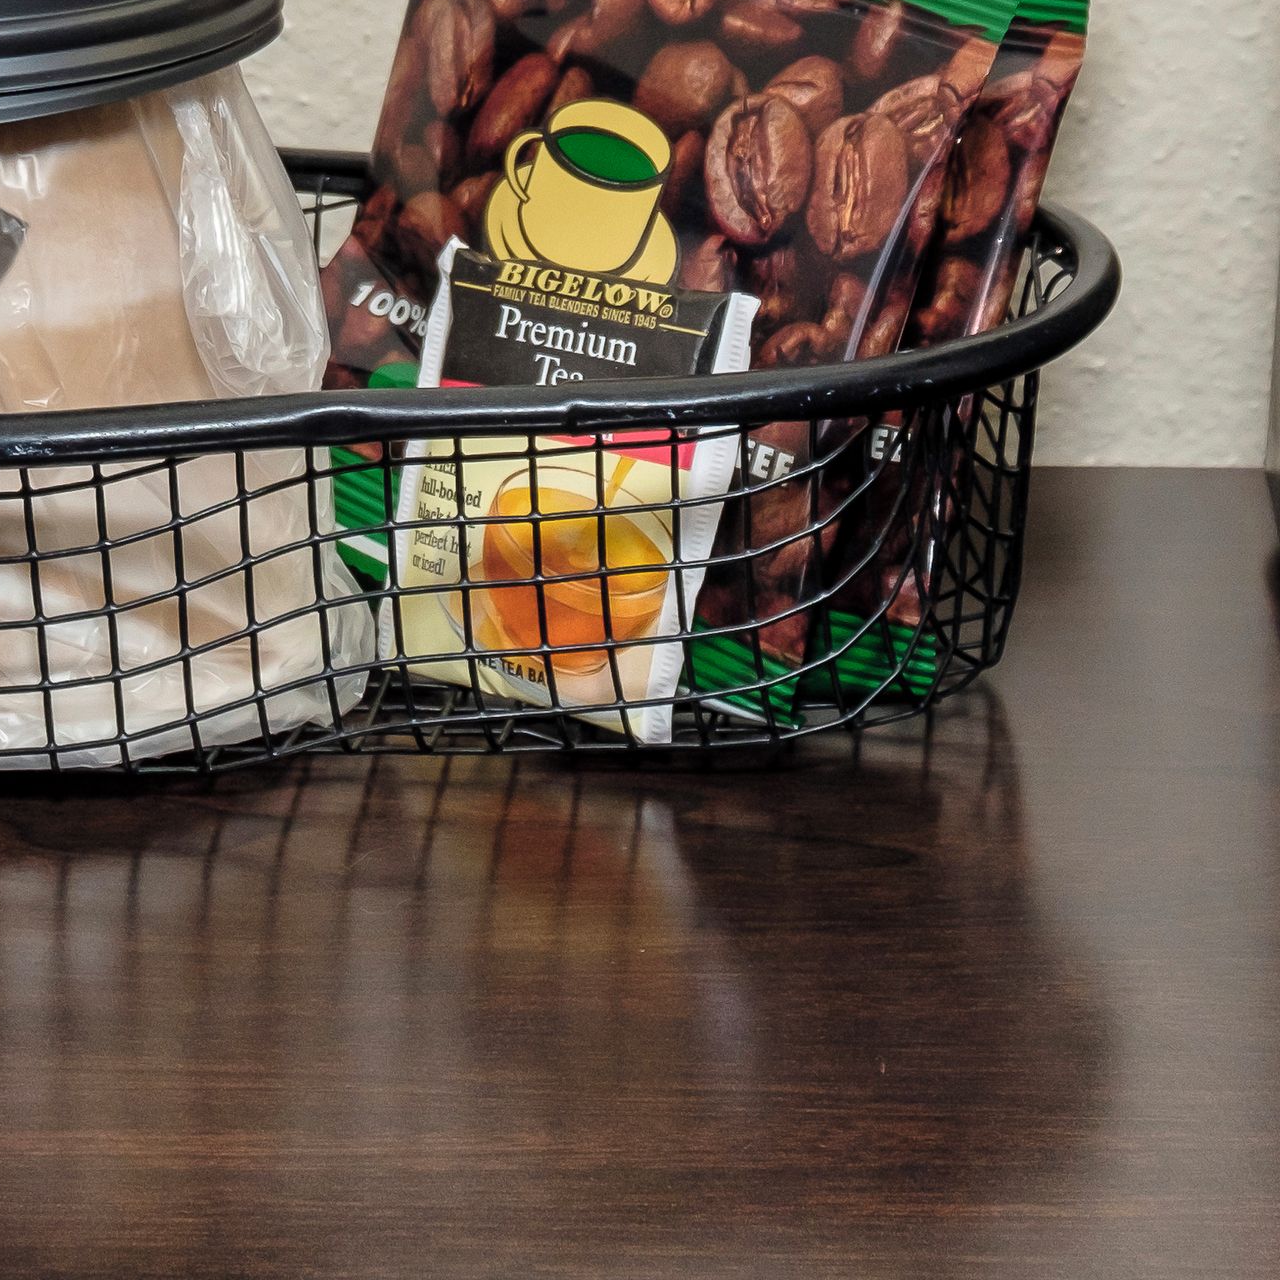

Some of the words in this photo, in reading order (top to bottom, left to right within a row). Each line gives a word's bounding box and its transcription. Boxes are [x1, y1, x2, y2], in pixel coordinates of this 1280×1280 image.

[350, 281, 427, 338] 100%
[493, 284, 527, 303] FAMILY
[529, 292, 546, 307] TEA
[548, 296, 599, 318] BLENDERS
[601, 307, 631, 326] SINCE
[496, 261, 673, 314] BIGELOW
[495, 304, 638, 367] Premium
[414, 529, 448, 552] perfect
[449, 535, 472, 560] ht
